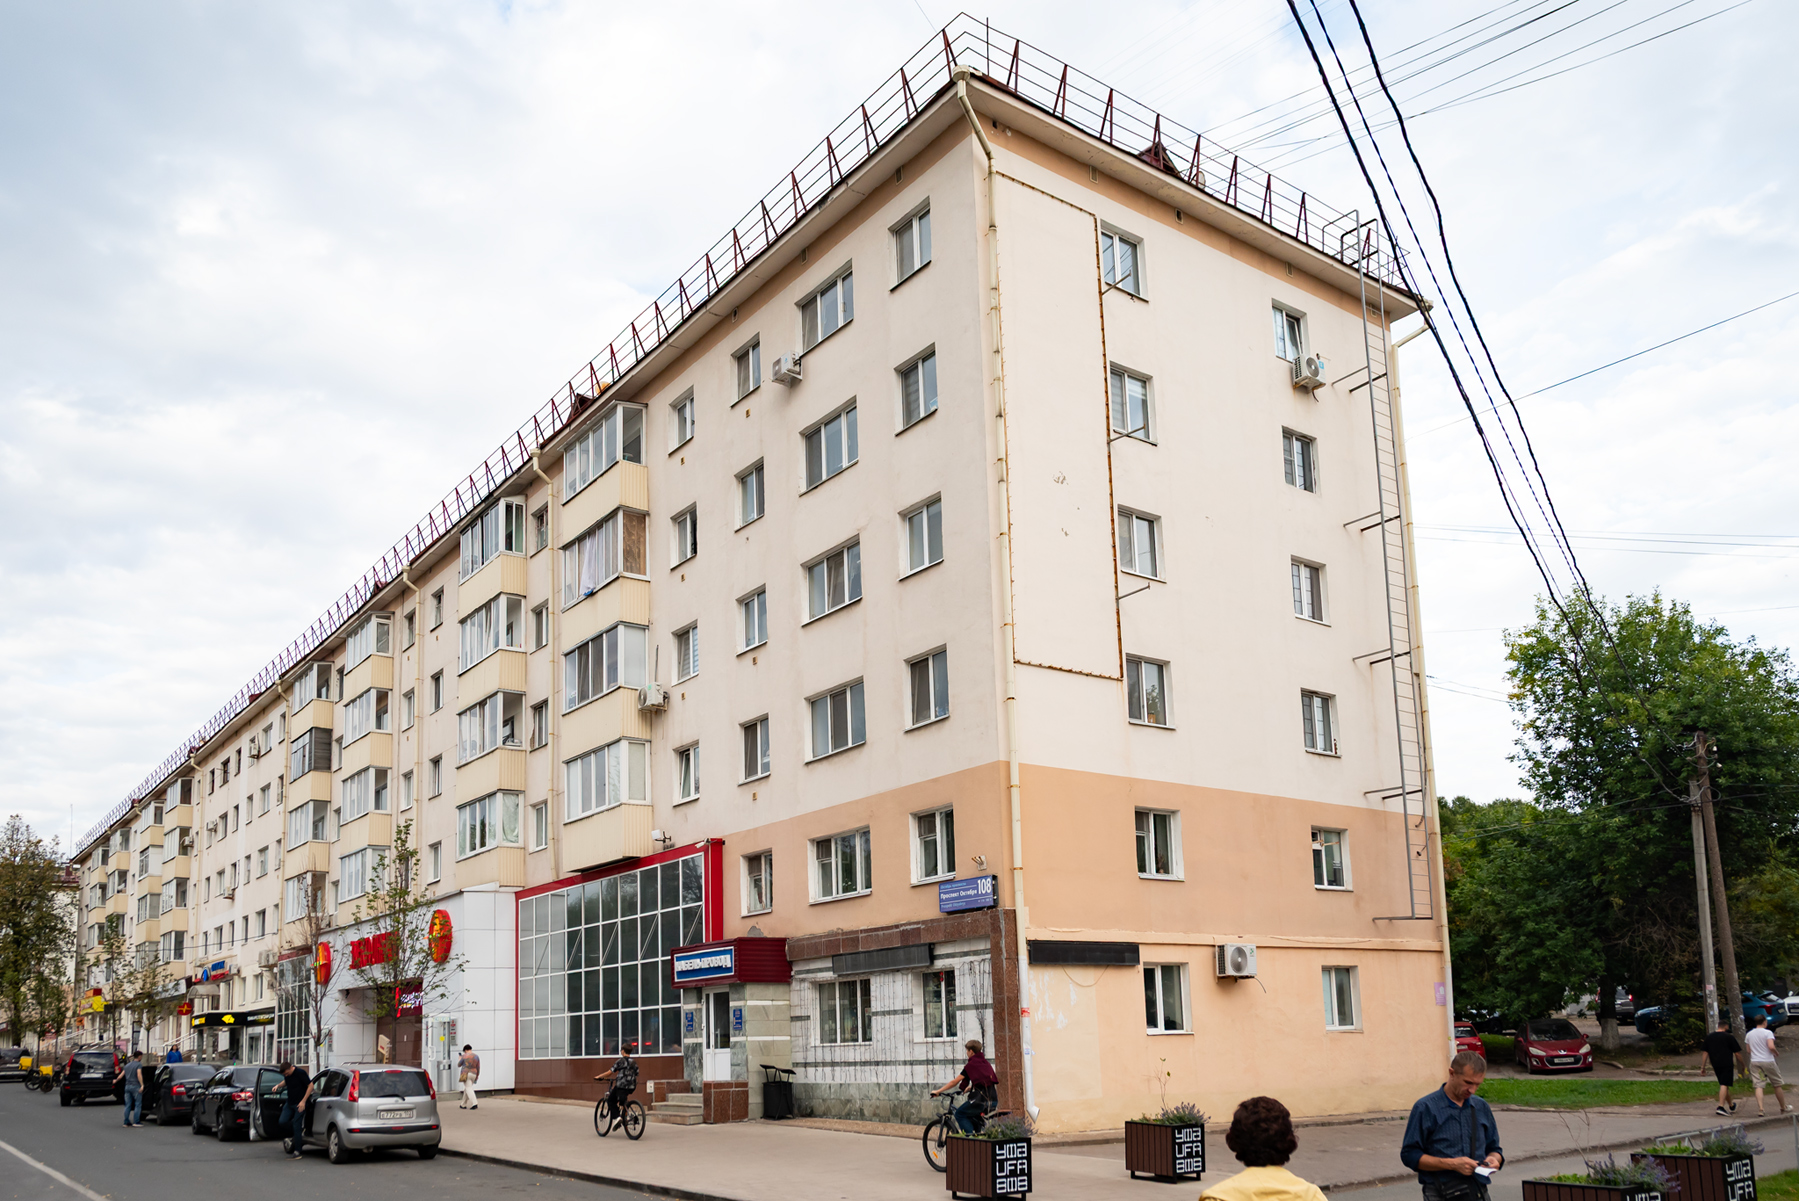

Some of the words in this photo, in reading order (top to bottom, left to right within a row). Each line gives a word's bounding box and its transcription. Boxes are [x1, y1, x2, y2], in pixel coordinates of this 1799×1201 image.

[977, 878, 992, 894] 108
[1176, 1142, 1201, 1157] UFA
[996, 1159, 1027, 1176] UFA
[1727, 1180, 1755, 1201] UFA
